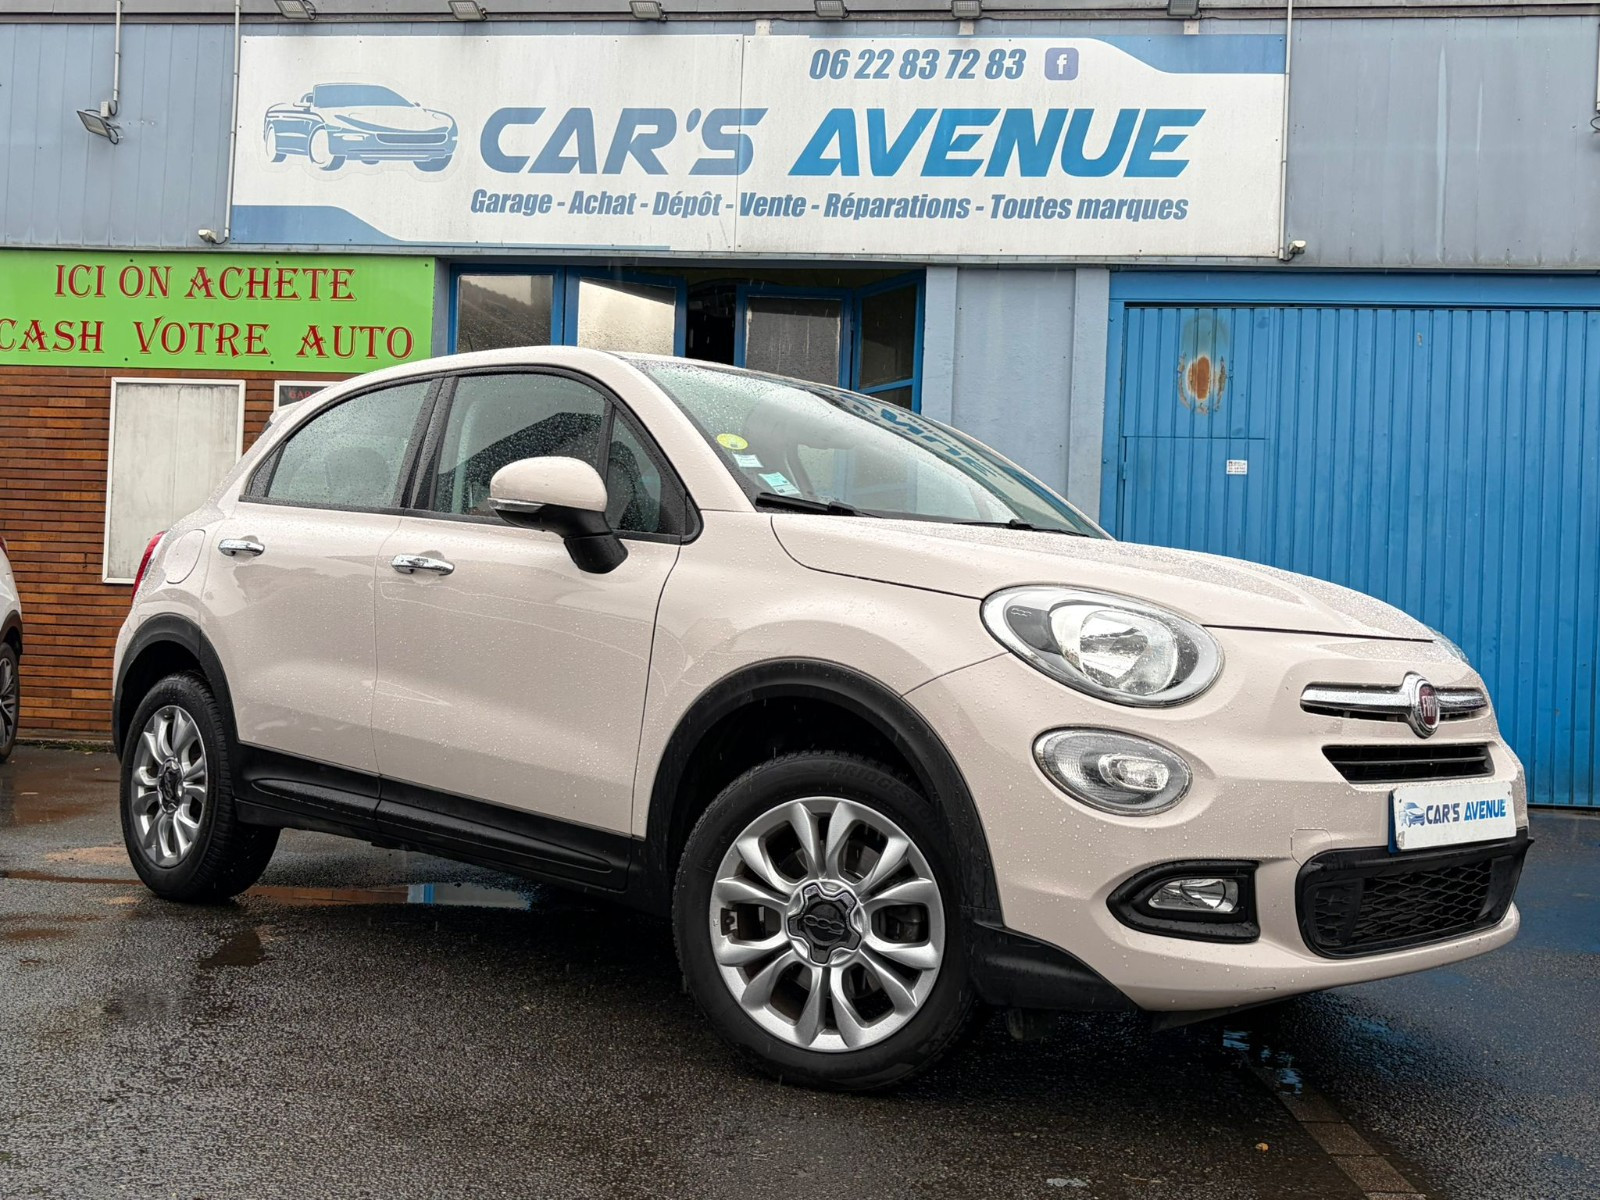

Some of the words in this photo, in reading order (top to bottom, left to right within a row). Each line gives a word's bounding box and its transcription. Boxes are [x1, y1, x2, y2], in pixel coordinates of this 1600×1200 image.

[809, 49, 850, 80] 06
[853, 49, 894, 80] 22
[899, 49, 940, 80] 83
[944, 49, 980, 80] 72
[984, 49, 1026, 80] 83
[480, 107, 769, 176] CAR'S
[787, 107, 1207, 178] AVENUE
[470, 188, 552, 216] Garage
[568, 190, 637, 216] Achat
[652, 190, 723, 219] Dépôt
[739, 191, 806, 217] Vente
[824, 192, 970, 221] Réparations
[990, 193, 1072, 220] Toutes
[1076, 196, 1188, 222] marques
[54, 264, 107, 298] ICI
[118, 265, 174, 299] ON
[184, 266, 357, 302] ACHETE
[0, 318, 105, 354] CASH
[133, 315, 271, 359] VOTRE
[296, 324, 415, 360] AUTO
[1425, 803, 1461, 825] CAR'S
[1464, 799, 1507, 821] AVENUE
